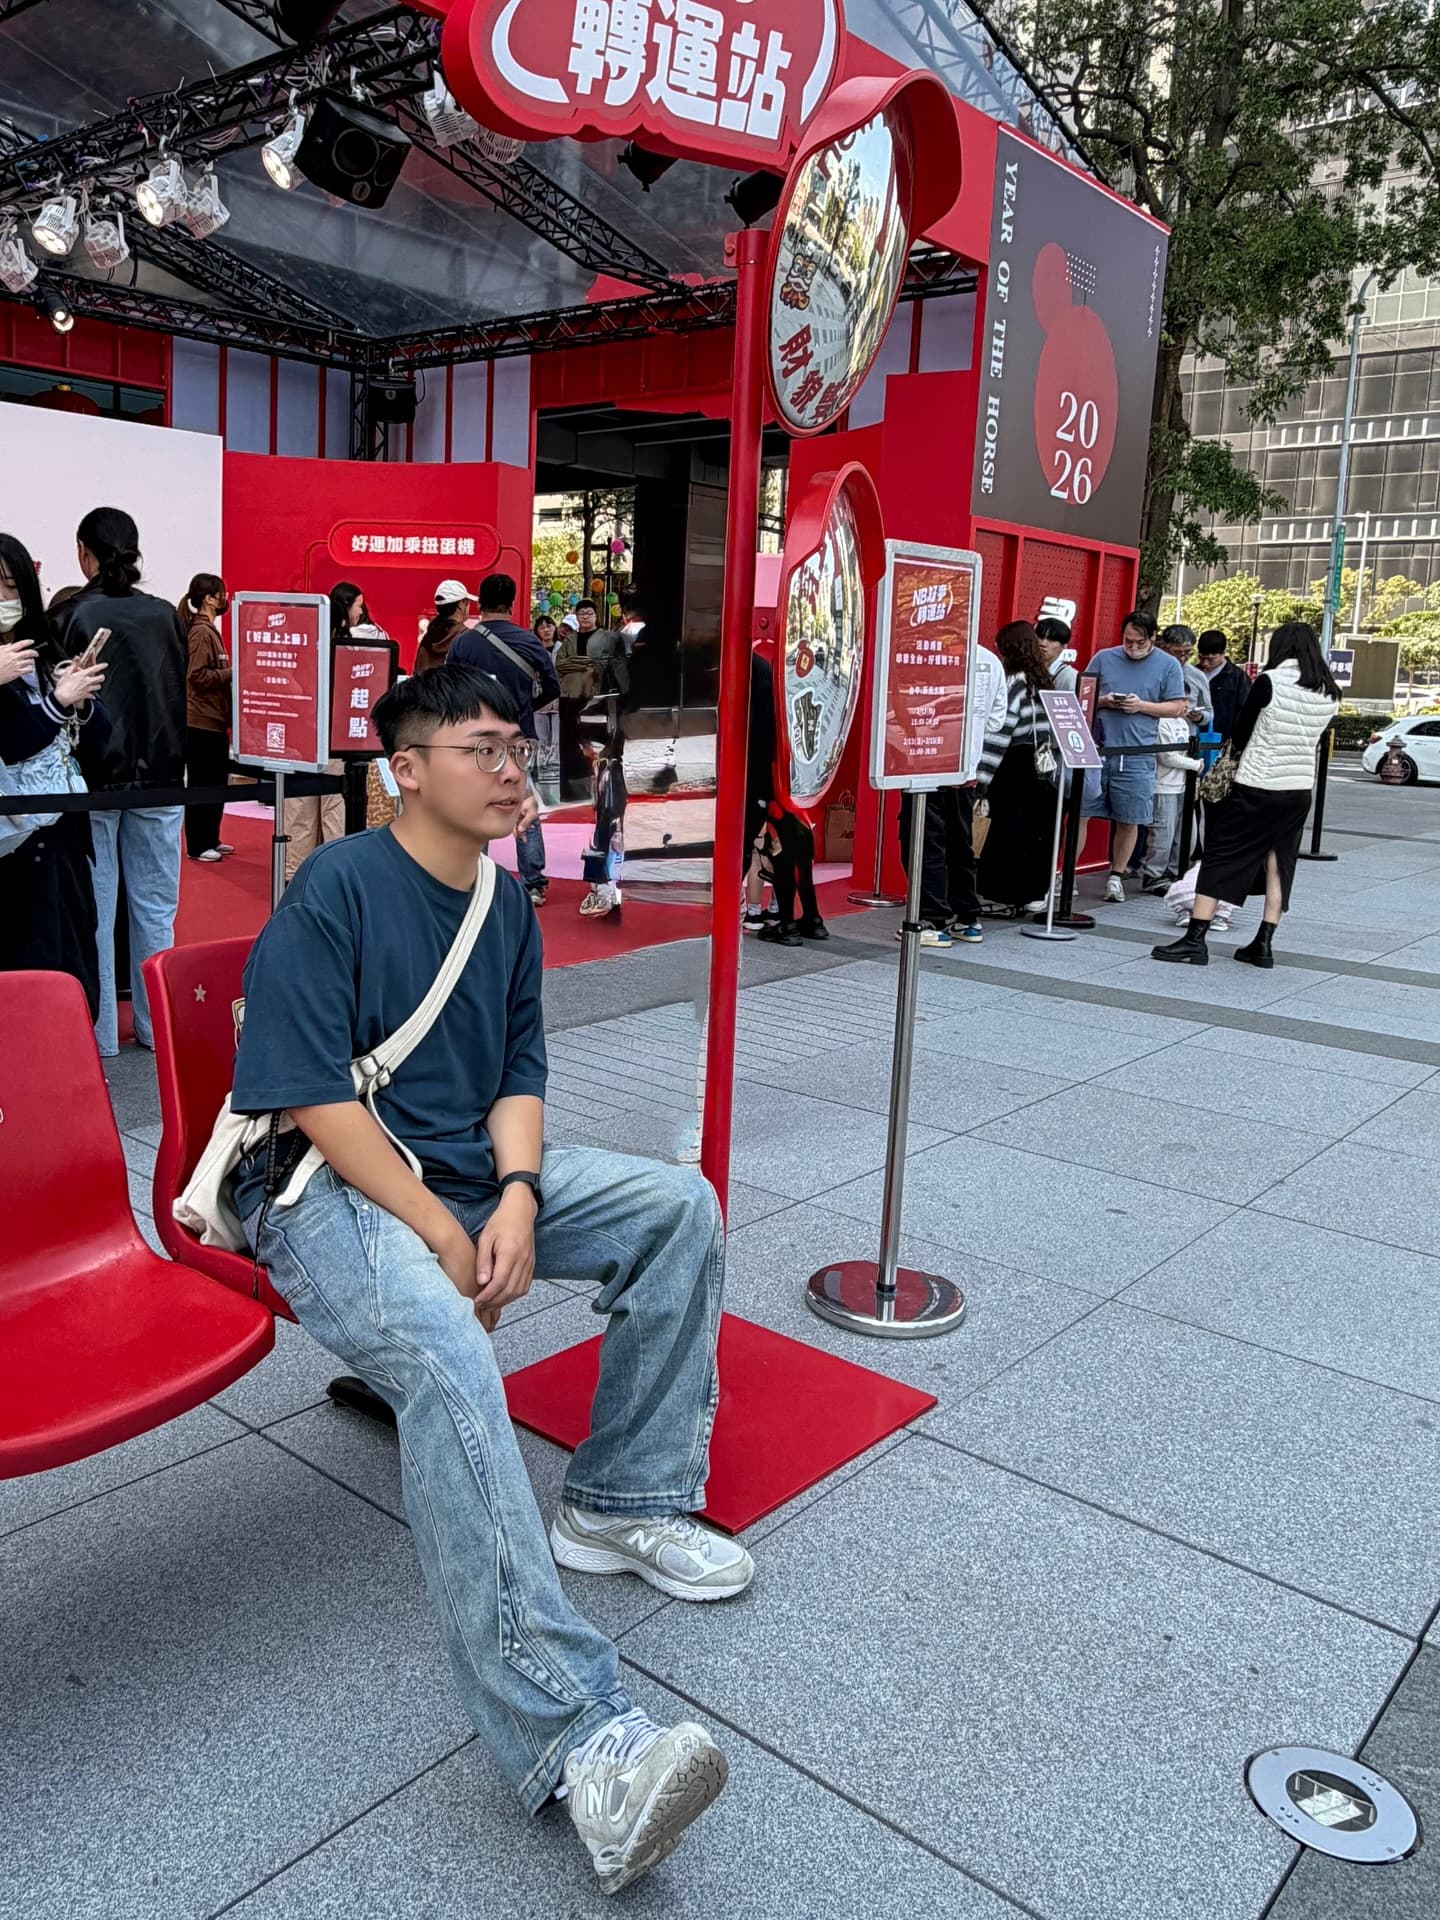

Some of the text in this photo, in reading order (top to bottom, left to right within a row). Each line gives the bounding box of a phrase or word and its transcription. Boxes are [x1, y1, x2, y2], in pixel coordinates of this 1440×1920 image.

[568, 0, 792, 140] 轉運站
[981, 162, 1019, 494] YEAR OF THE HORSE
[1055, 391, 1099, 449] 20
[1050, 449, 1093, 505] 26
[351, 535, 476, 556] 好運加乘扭蛋機
[349, 687, 369, 738] 起點
[626, 1528, 658, 1553] N
[586, 1779, 606, 1818] N
